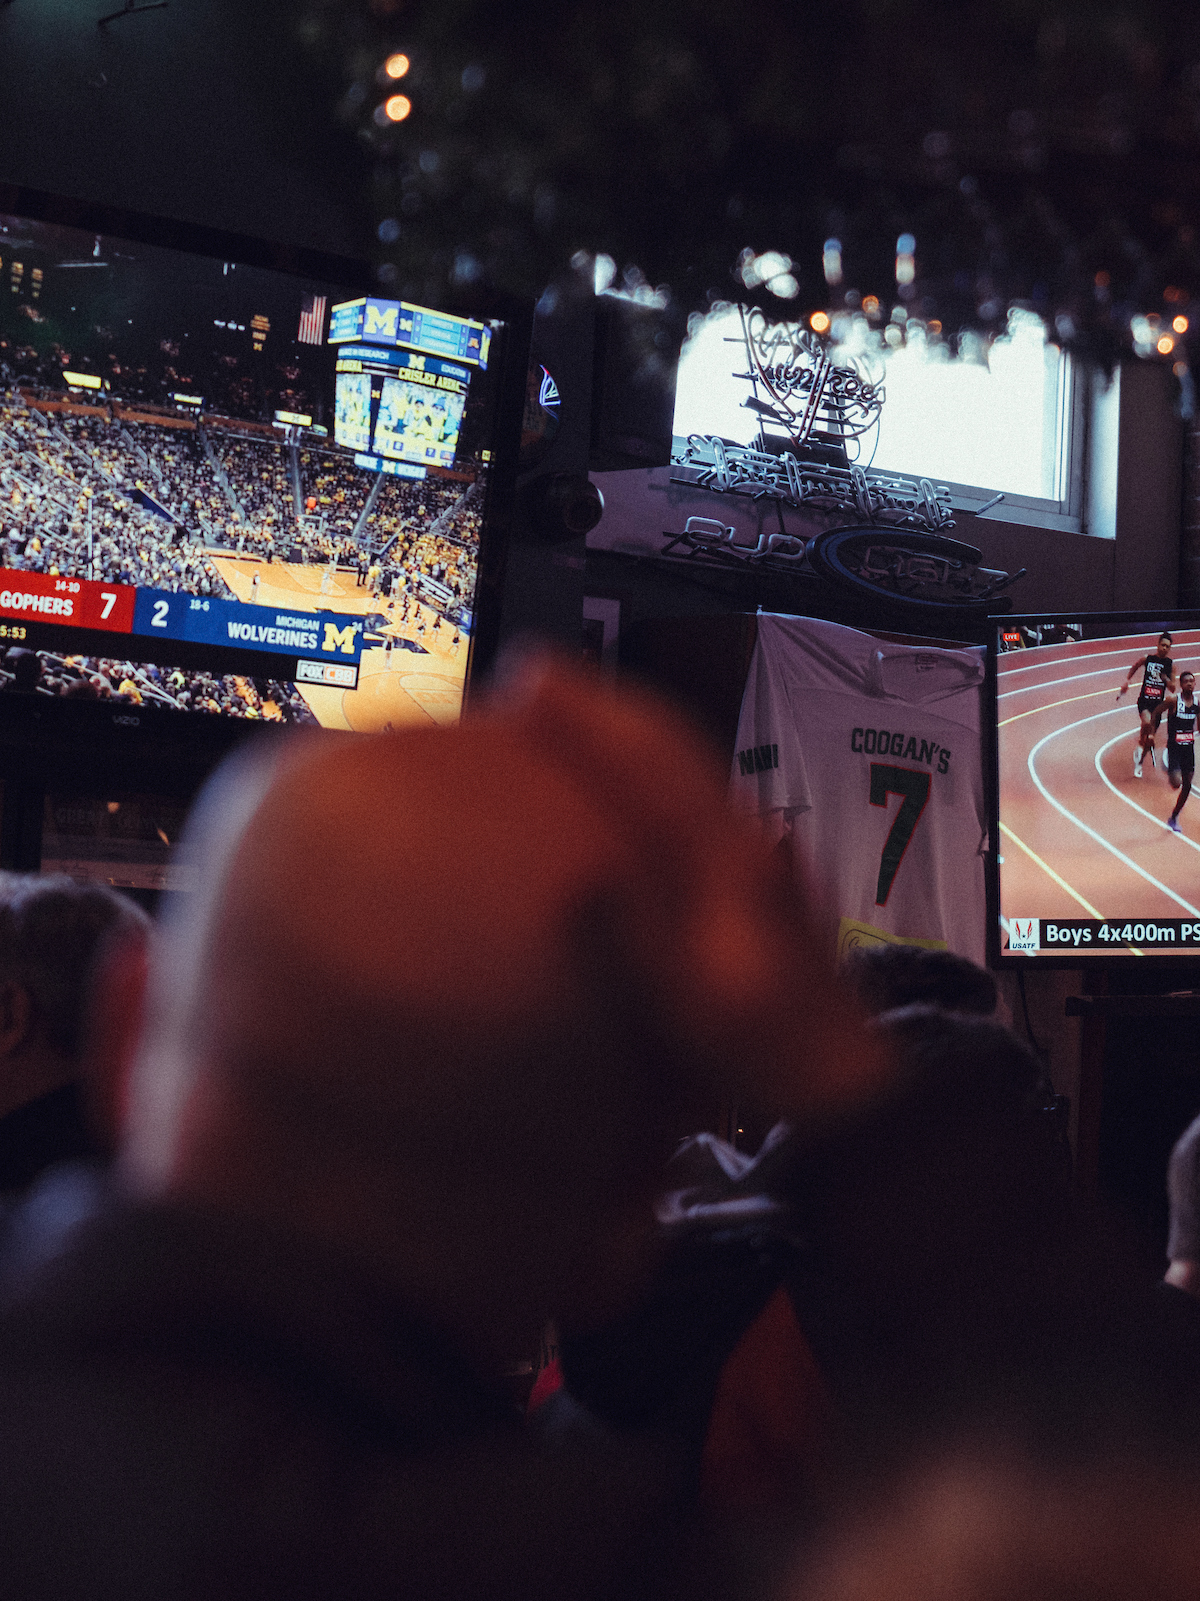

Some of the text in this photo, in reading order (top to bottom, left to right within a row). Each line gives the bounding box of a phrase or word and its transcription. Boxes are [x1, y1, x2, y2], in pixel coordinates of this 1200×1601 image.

[0, 590, 74, 616] GOPHERS
[100, 592, 117, 620] 7
[151, 600, 170, 628] 2
[227, 621, 319, 650] WOLVERINES
[275, 615, 320, 632] MICHIGAN
[321, 622, 357, 655] M
[299, 665, 355, 683] FOX CBB
[851, 727, 951, 775] COOGAN'S
[869, 762, 932, 907] 7
[1046, 923, 1092, 946] Boys
[1098, 923, 1176, 942] 4x400m
